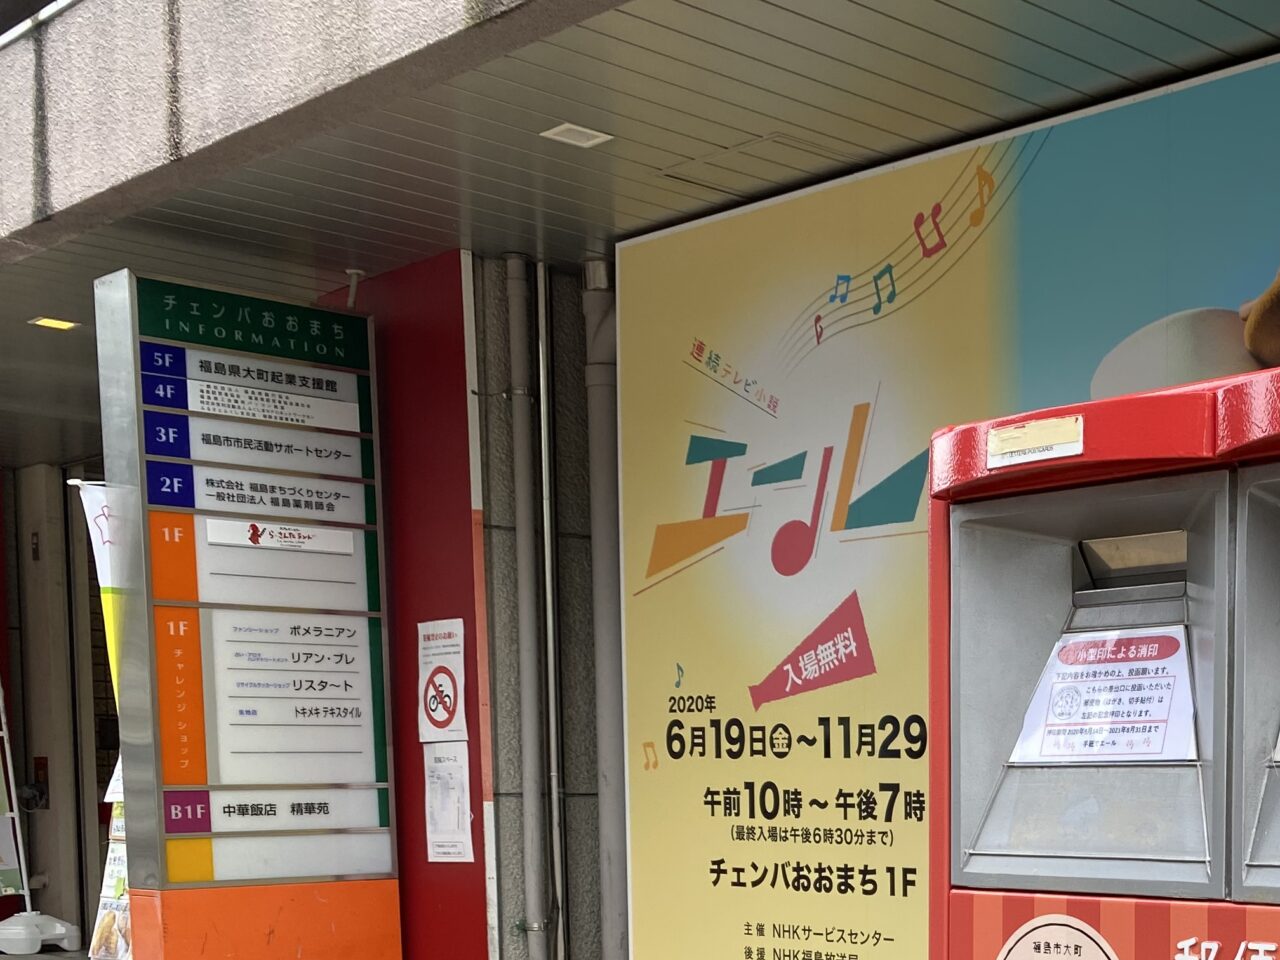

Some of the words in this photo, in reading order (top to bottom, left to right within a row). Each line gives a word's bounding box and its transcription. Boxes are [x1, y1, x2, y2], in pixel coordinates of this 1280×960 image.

[163, 294, 344, 341] チェンバおおまち
[164, 319, 346, 358] INFORMATION
[153, 352, 174, 368] 5F
[199, 359, 338, 393] 福島県大町起業支援館
[690, 337, 781, 415] 連続テレビ小説
[155, 384, 176, 399] 4F
[155, 426, 179, 443] 3F
[201, 432, 352, 461] 福島市市民活動サポートセンター
[160, 476, 184, 493] 2F
[205, 478, 244, 491] 株式会社
[249, 482, 351, 501] 福島まちづくりセンター
[645, 402, 929, 579] エール
[205, 491, 267, 506] 一般社団法人
[270, 496, 336, 512] 福島薬剤師会
[162, 527, 184, 543] 1F
[166, 620, 189, 636] 1F
[289, 624, 357, 639] ポメラニアン
[783, 627, 857, 693] 入場無料
[1077, 643, 1159, 661] 小型印による消印
[668, 694, 716, 713] 2020年
[170, 803, 206, 821] B1F
[222, 803, 278, 818] 中華飯店
[289, 802, 331, 816] 精華苑
[730, 825, 895, 848] (最終入場は午後6時30分まで)
[743, 921, 766, 937] 主催
[772, 922, 895, 947] NHKサービスセンター
[1032, 940, 1083, 957] 福島市大町
